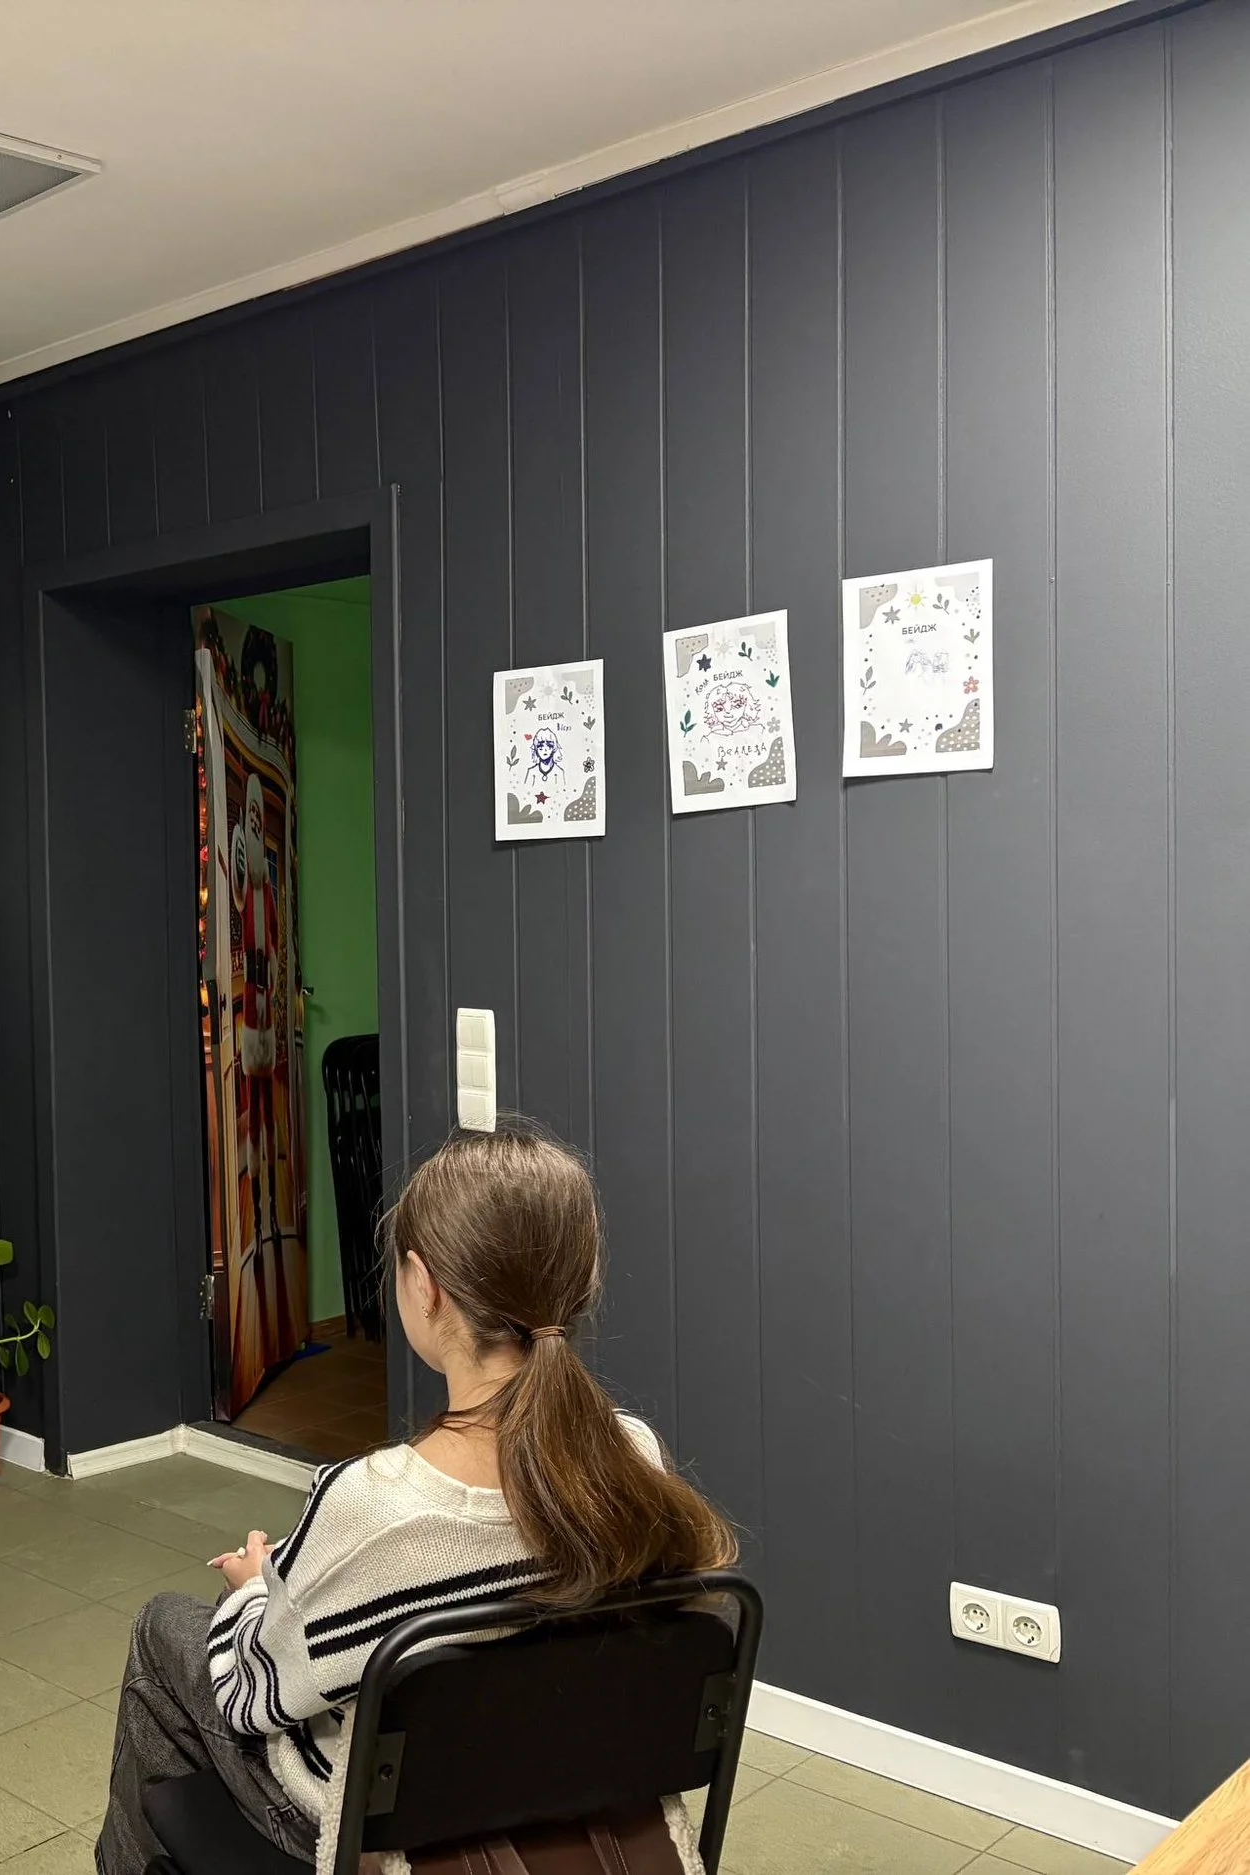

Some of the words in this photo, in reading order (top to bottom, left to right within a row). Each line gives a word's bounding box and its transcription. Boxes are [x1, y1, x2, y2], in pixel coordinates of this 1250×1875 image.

[902, 623, 937, 635] БЕЙДЖ
[713, 669, 743, 682] БЕЙДЖ
[538, 711, 565, 722] БЕЙДЖ
